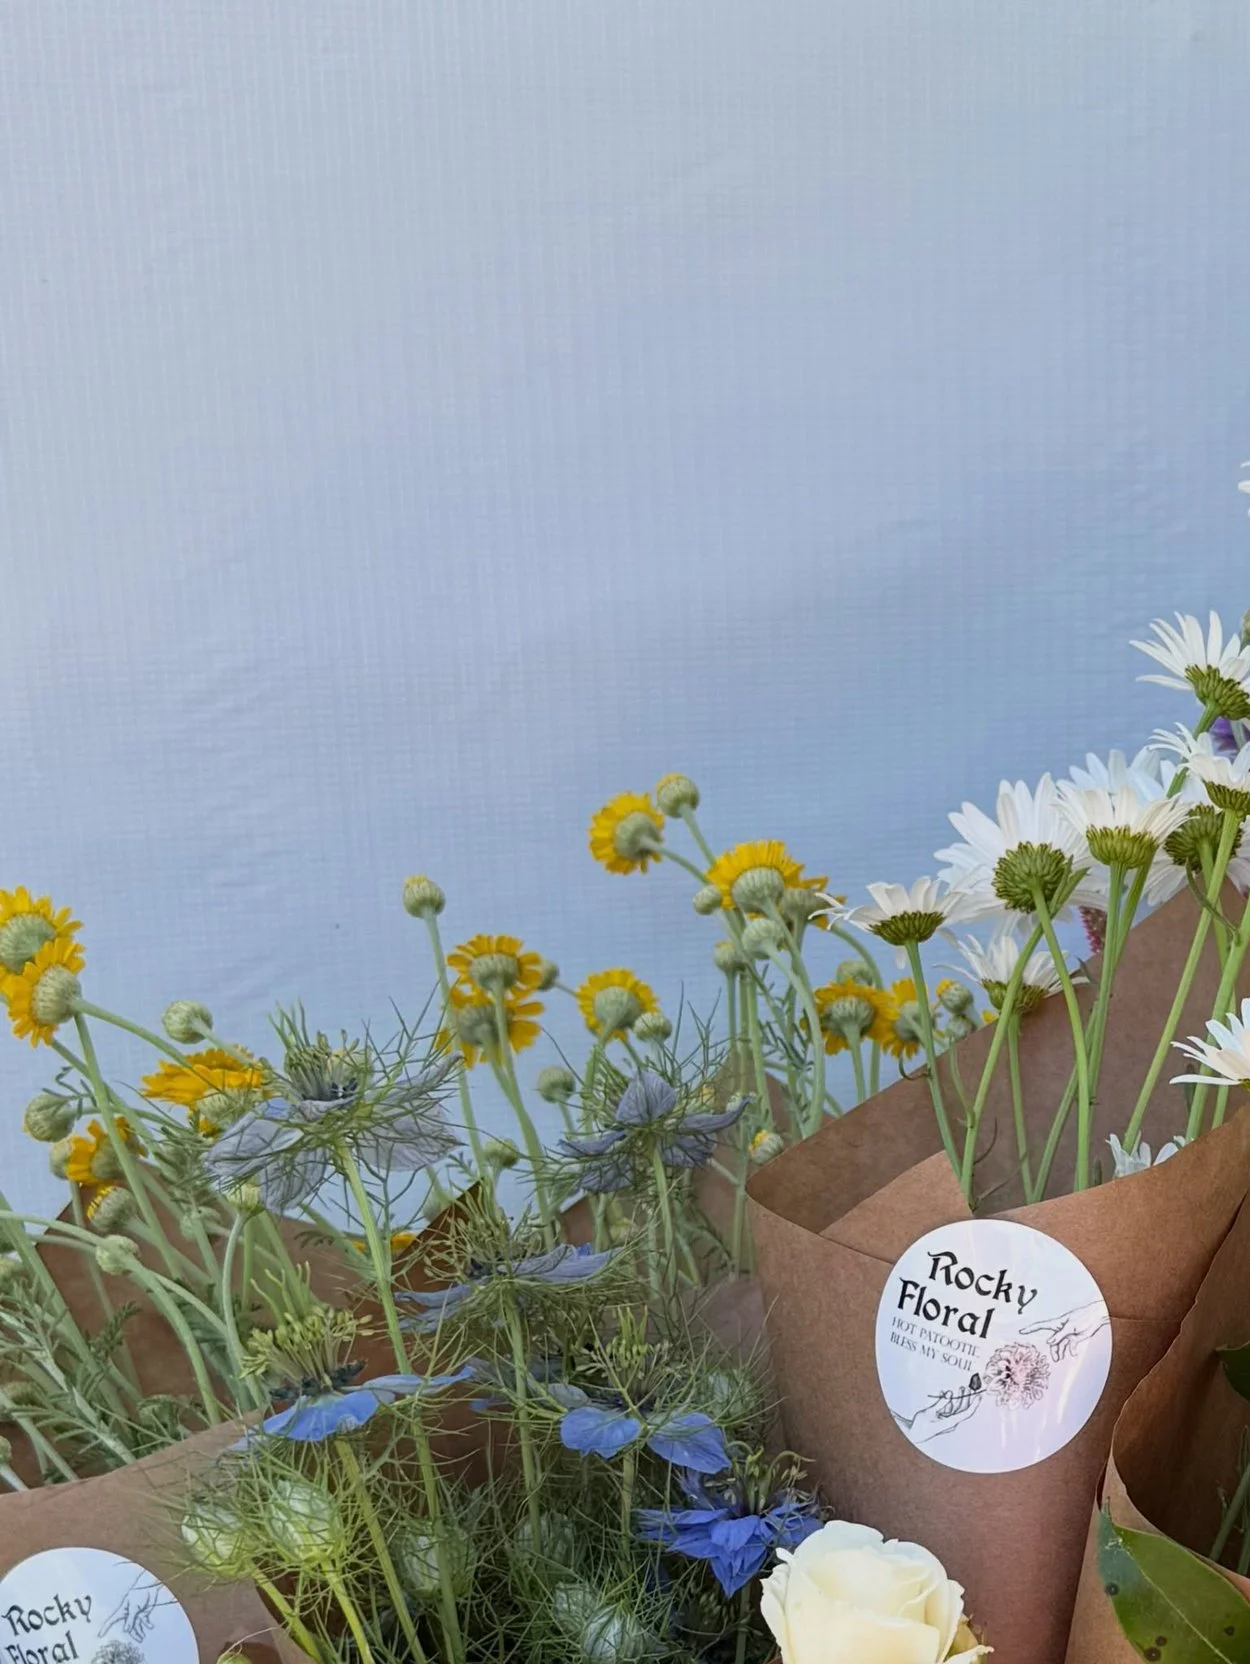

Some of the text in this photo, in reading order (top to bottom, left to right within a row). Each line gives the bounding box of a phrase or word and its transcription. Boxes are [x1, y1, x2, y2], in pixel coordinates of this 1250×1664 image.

[927, 1250, 1038, 1315] Rocky
[892, 1316, 917, 1335] HOT
[897, 1277, 996, 1340] Floral
[890, 1331, 918, 1352] BLESS
[920, 1344, 939, 1361] MY
[1, 1593, 92, 1637] Rocky
